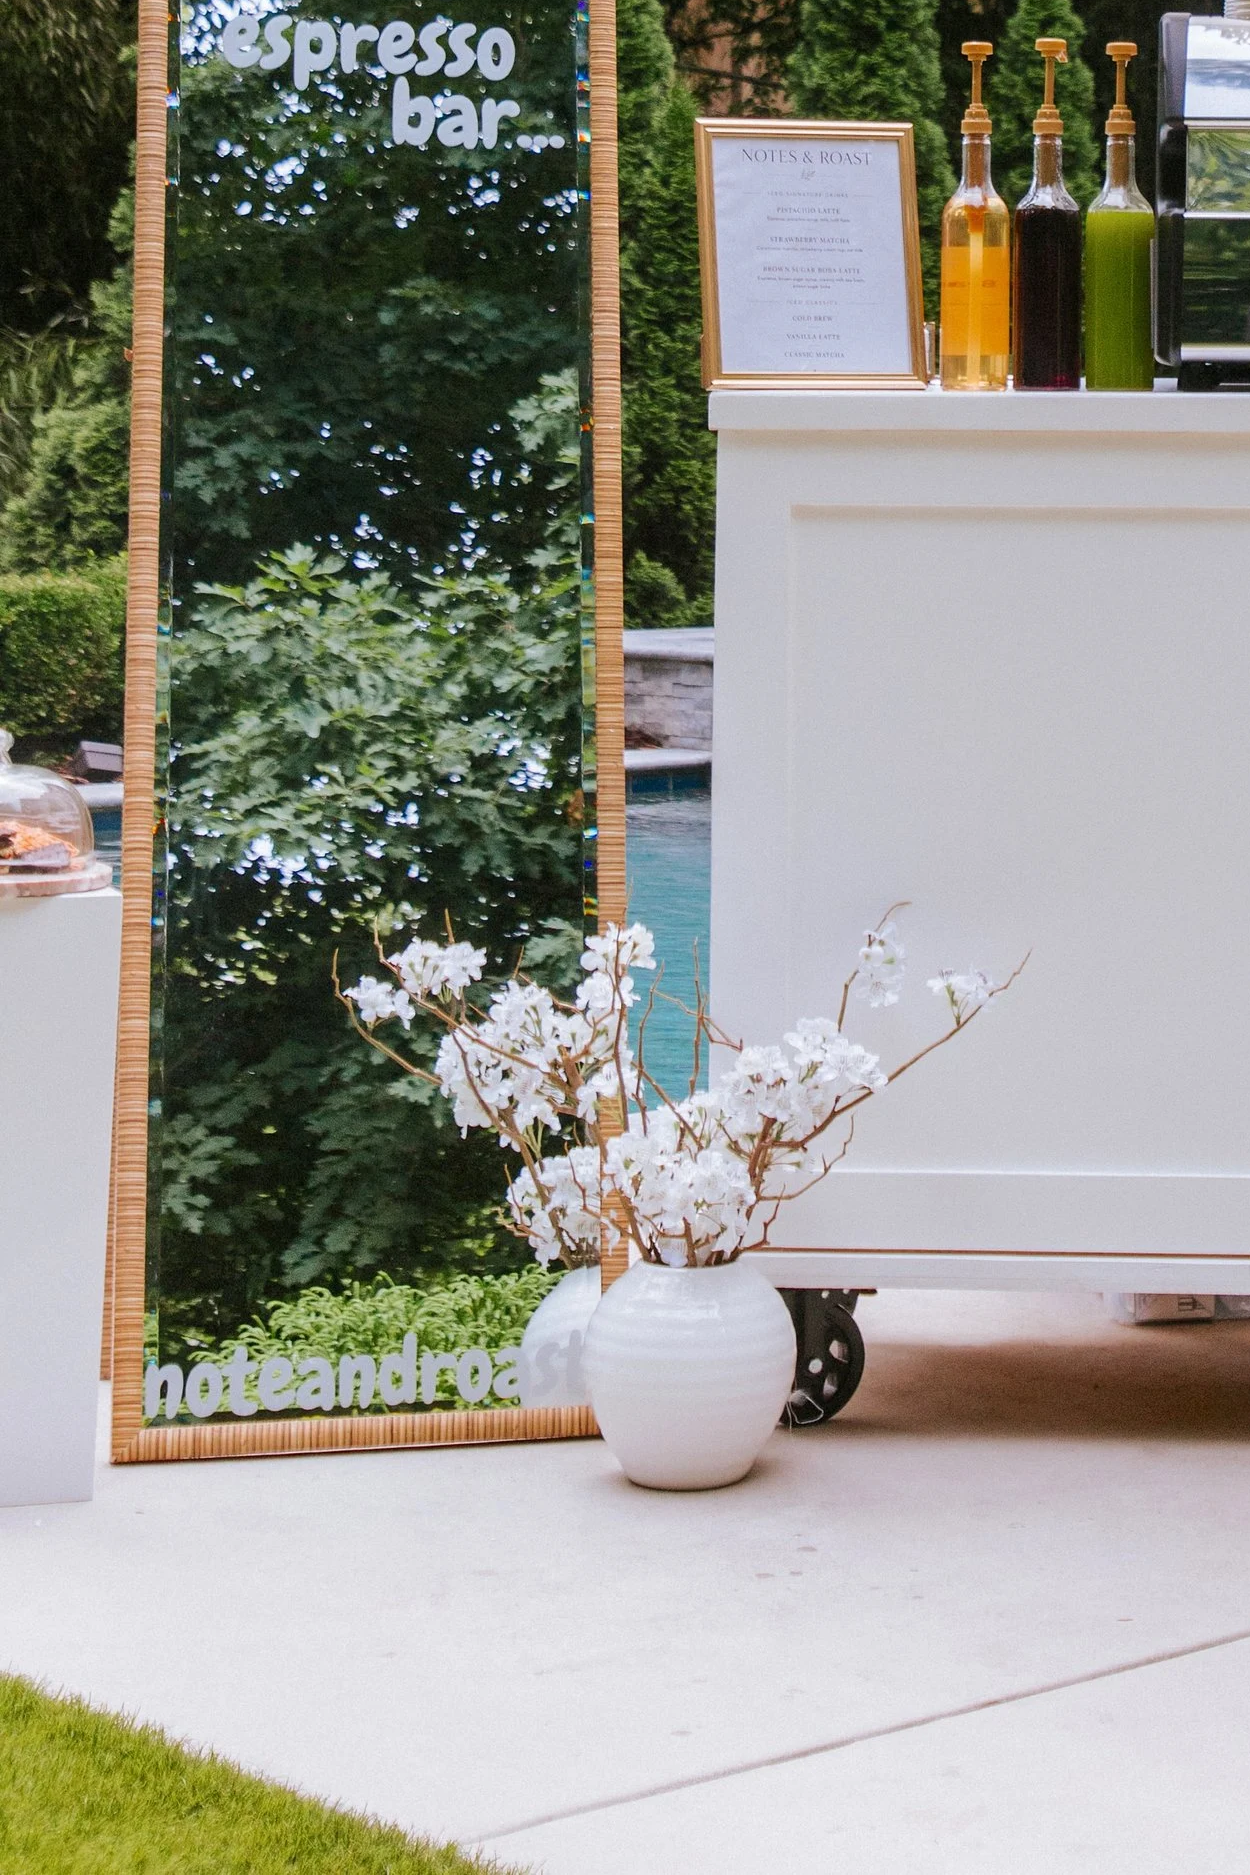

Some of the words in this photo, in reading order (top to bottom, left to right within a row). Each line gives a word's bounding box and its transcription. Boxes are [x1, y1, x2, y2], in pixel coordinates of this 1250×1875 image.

[222, 14, 516, 91] espresso
[741, 148, 798, 164] NOTES
[802, 150, 814, 164] &
[819, 150, 872, 166] ROAST
[776, 206, 816, 214] PISTACHIO
[818, 207, 841, 215] LATTE
[769, 236, 817, 244] STRAWBERRY
[819, 237, 850, 245] MATCHA
[763, 265, 791, 273] BROWN
[792, 266, 816, 274] SUGAR
[817, 267, 837, 275] BOBA
[839, 267, 860, 275] LATTE
[786, 333, 817, 341] VANILLA
[818, 333, 841, 341] LATTE
[815, 351, 846, 359] MATCHA
[144, 1328, 586, 1420] noteandroast
